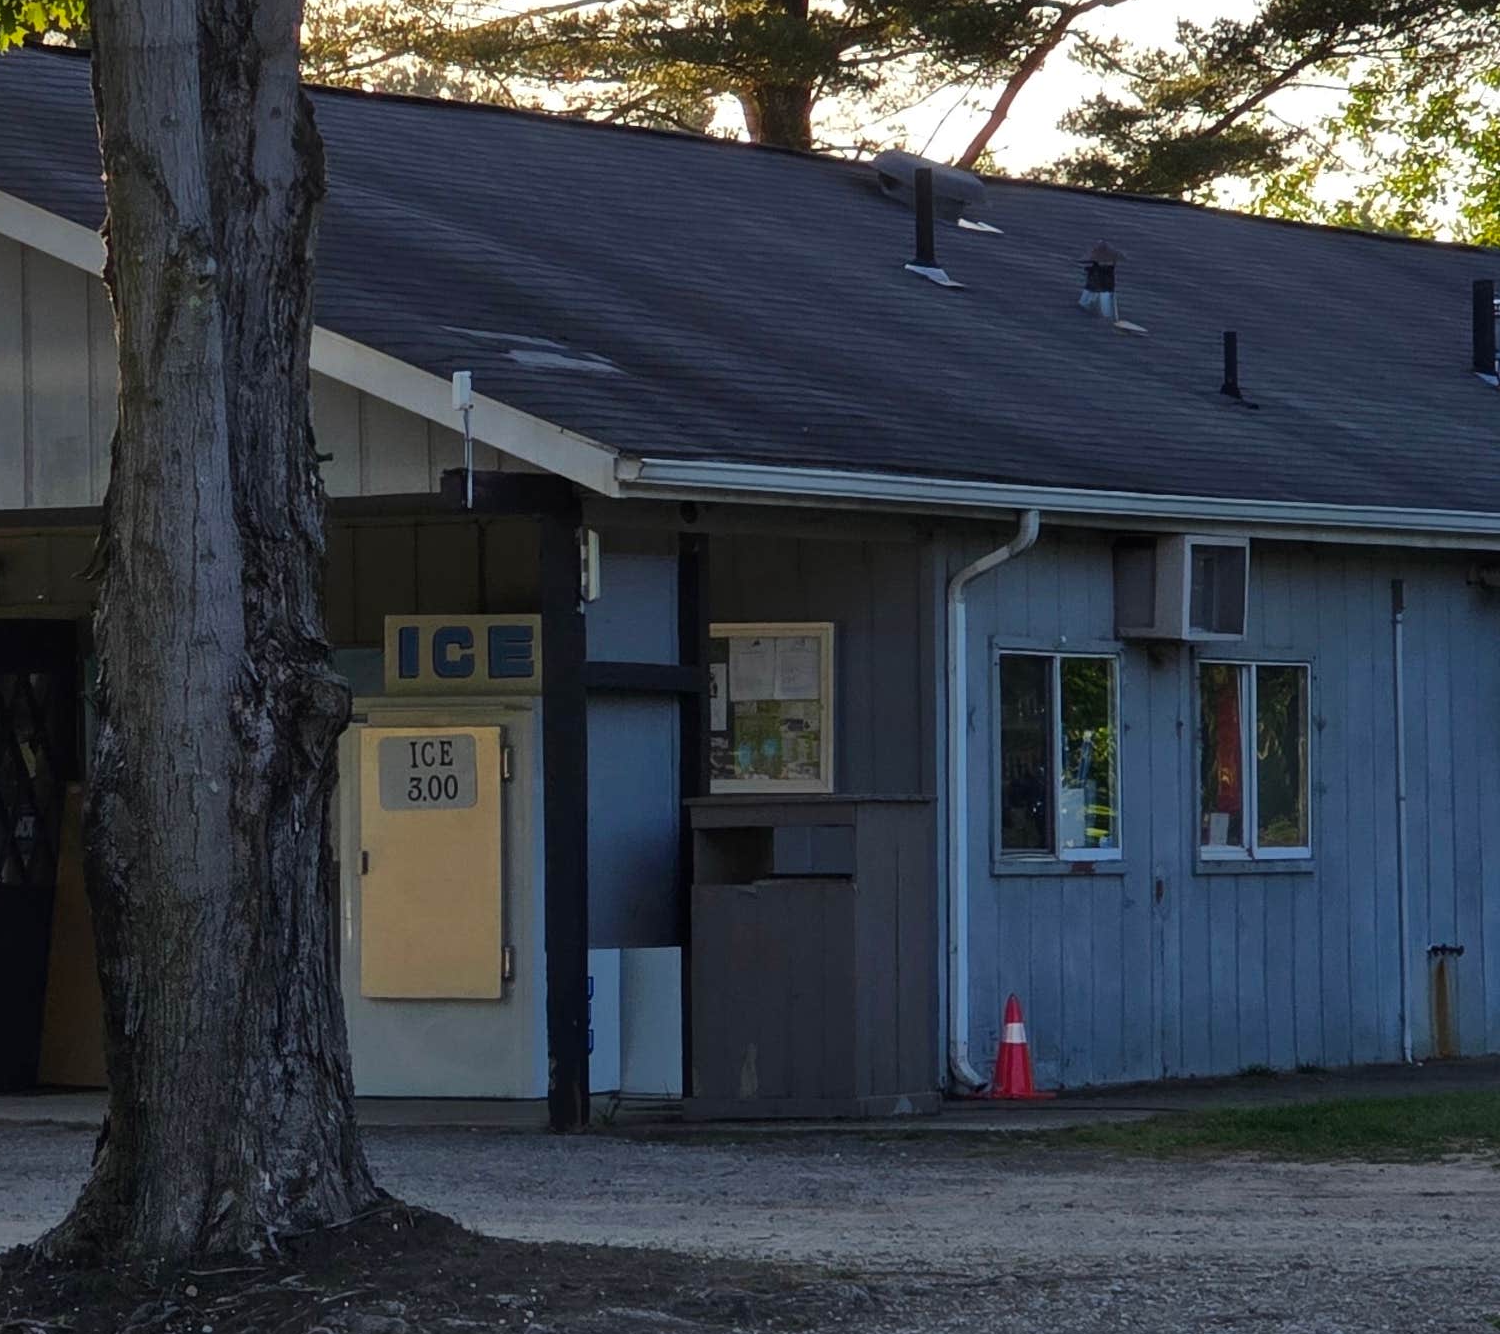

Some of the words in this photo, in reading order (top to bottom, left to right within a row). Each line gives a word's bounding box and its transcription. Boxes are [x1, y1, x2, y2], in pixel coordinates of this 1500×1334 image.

[398, 625, 535, 680] ICE
[409, 740, 454, 769] ICE
[407, 774, 459, 802] 3.00
